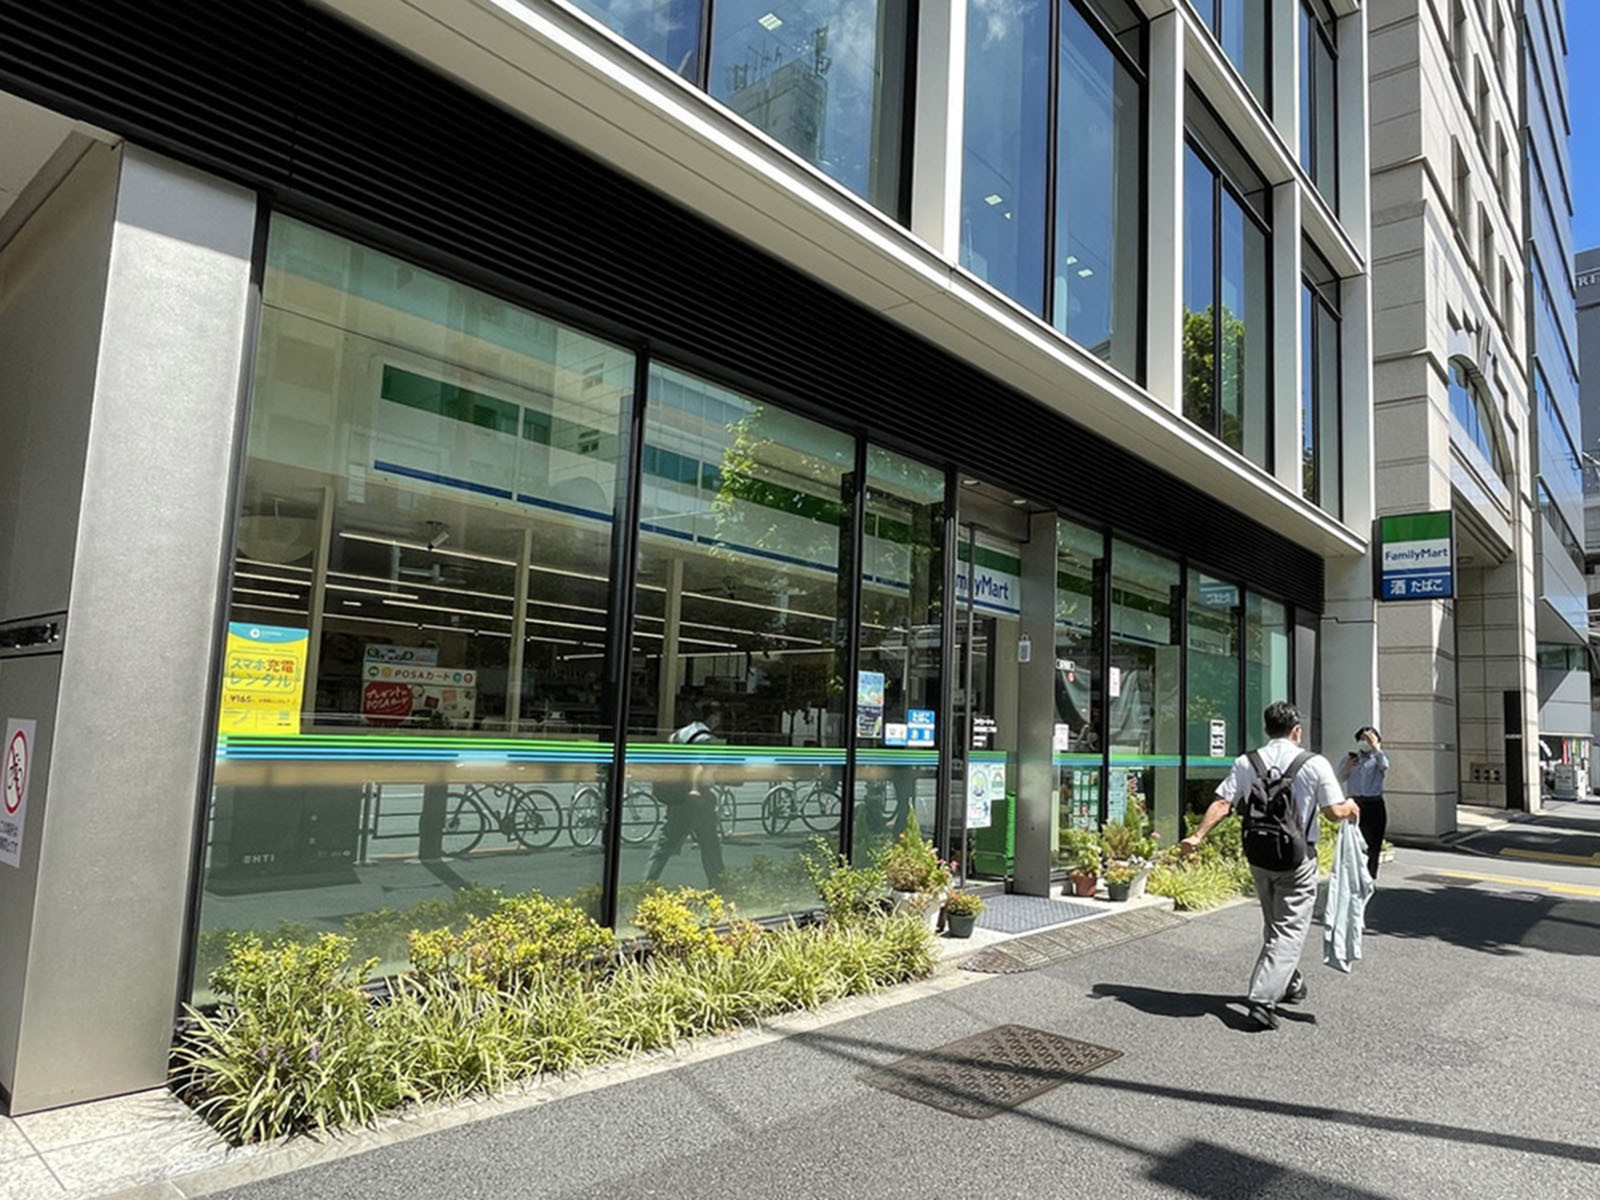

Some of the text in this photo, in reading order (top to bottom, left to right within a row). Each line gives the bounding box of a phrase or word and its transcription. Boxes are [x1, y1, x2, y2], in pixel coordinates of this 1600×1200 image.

[1385, 548, 1448, 561] FamilyMart
[1390, 578, 1443, 595] 酒 たばこ
[230, 657, 295, 673] スマホ充電
[230, 672, 291, 688] レンタル
